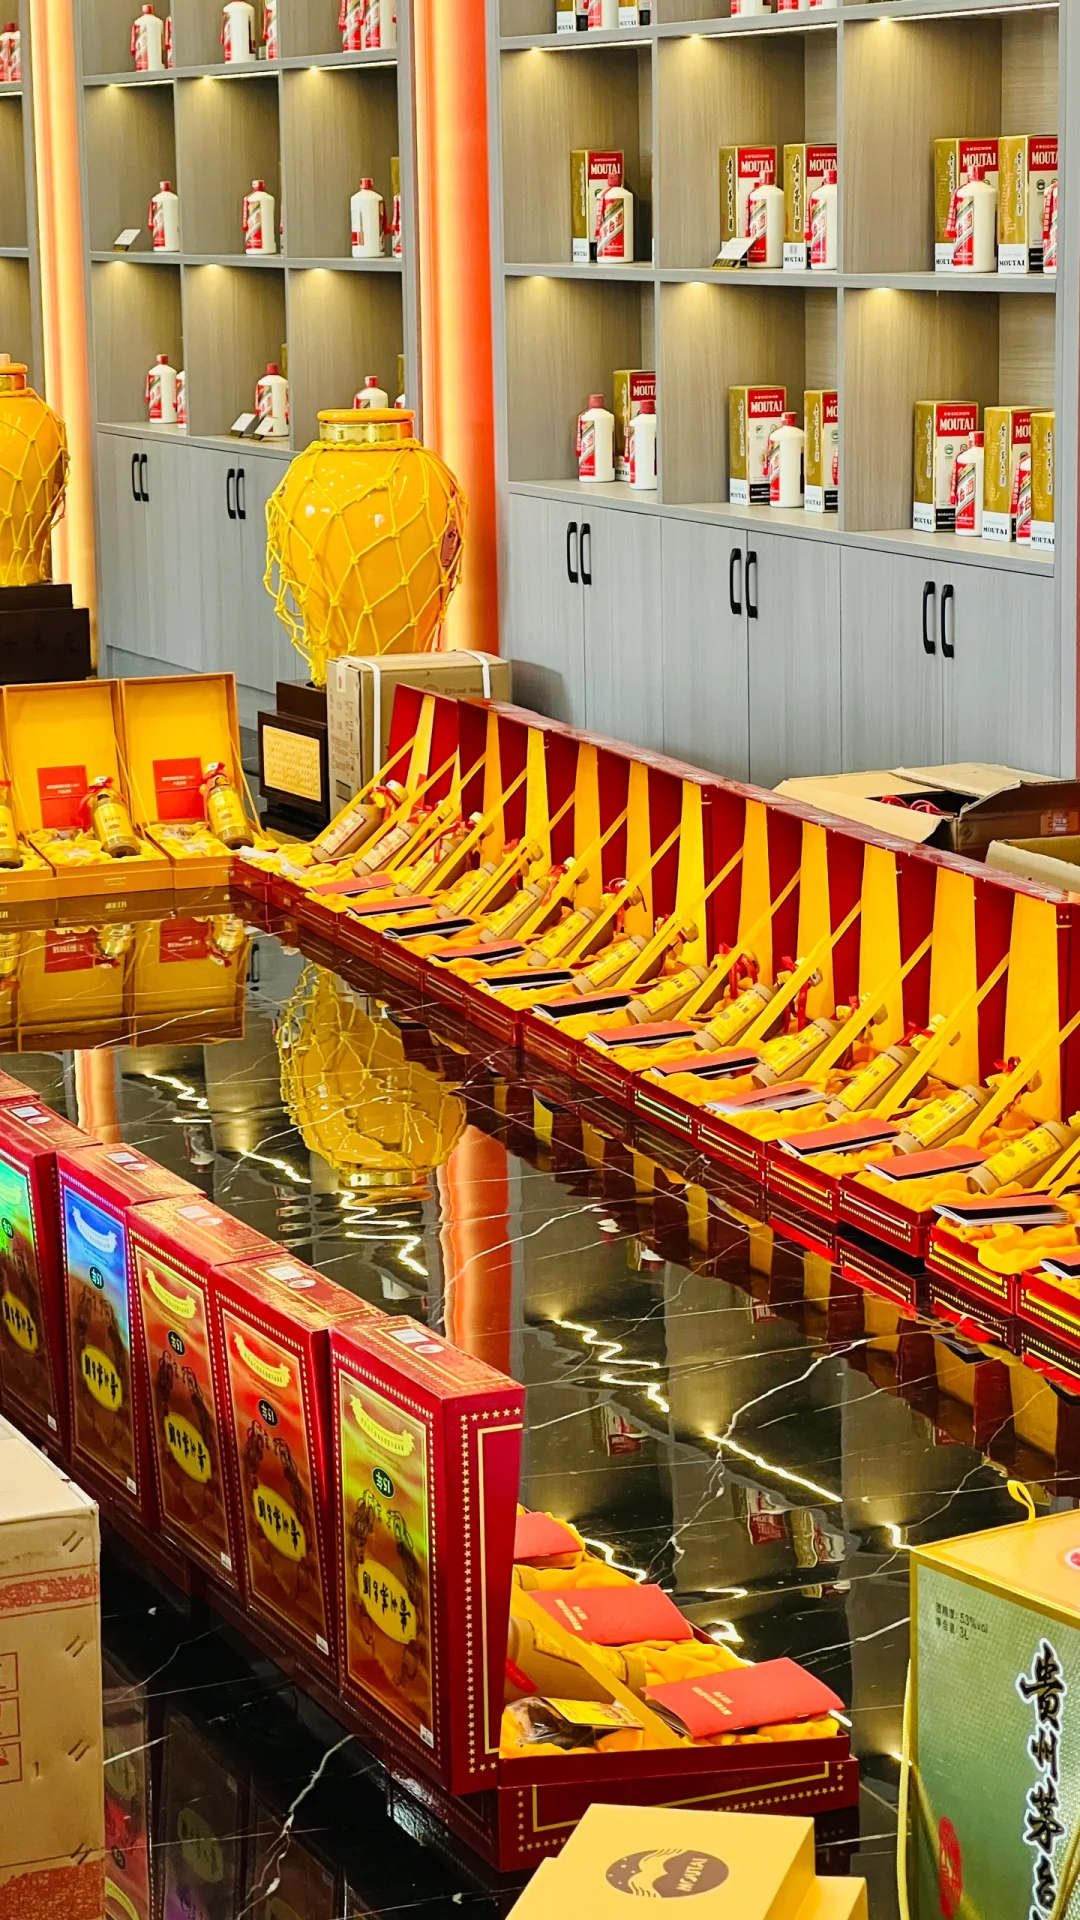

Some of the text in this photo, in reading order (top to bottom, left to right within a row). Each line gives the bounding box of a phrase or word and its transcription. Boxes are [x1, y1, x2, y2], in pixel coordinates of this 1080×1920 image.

[809, 158, 837, 171] MOUTA
[962, 152, 996, 166] MOUTAI
[1032, 151, 1058, 165] MOUTA
[590, 164, 621, 175] MOUTAI
[741, 160, 774, 172] MOUTAI
[633, 386, 656, 396] MOUT
[750, 400, 783, 413] MOUTAI
[940, 418, 974, 431] MOUTAI
[376, 1472, 391, 1494] 15年
[676, 1858, 708, 1892] MOUTAI
